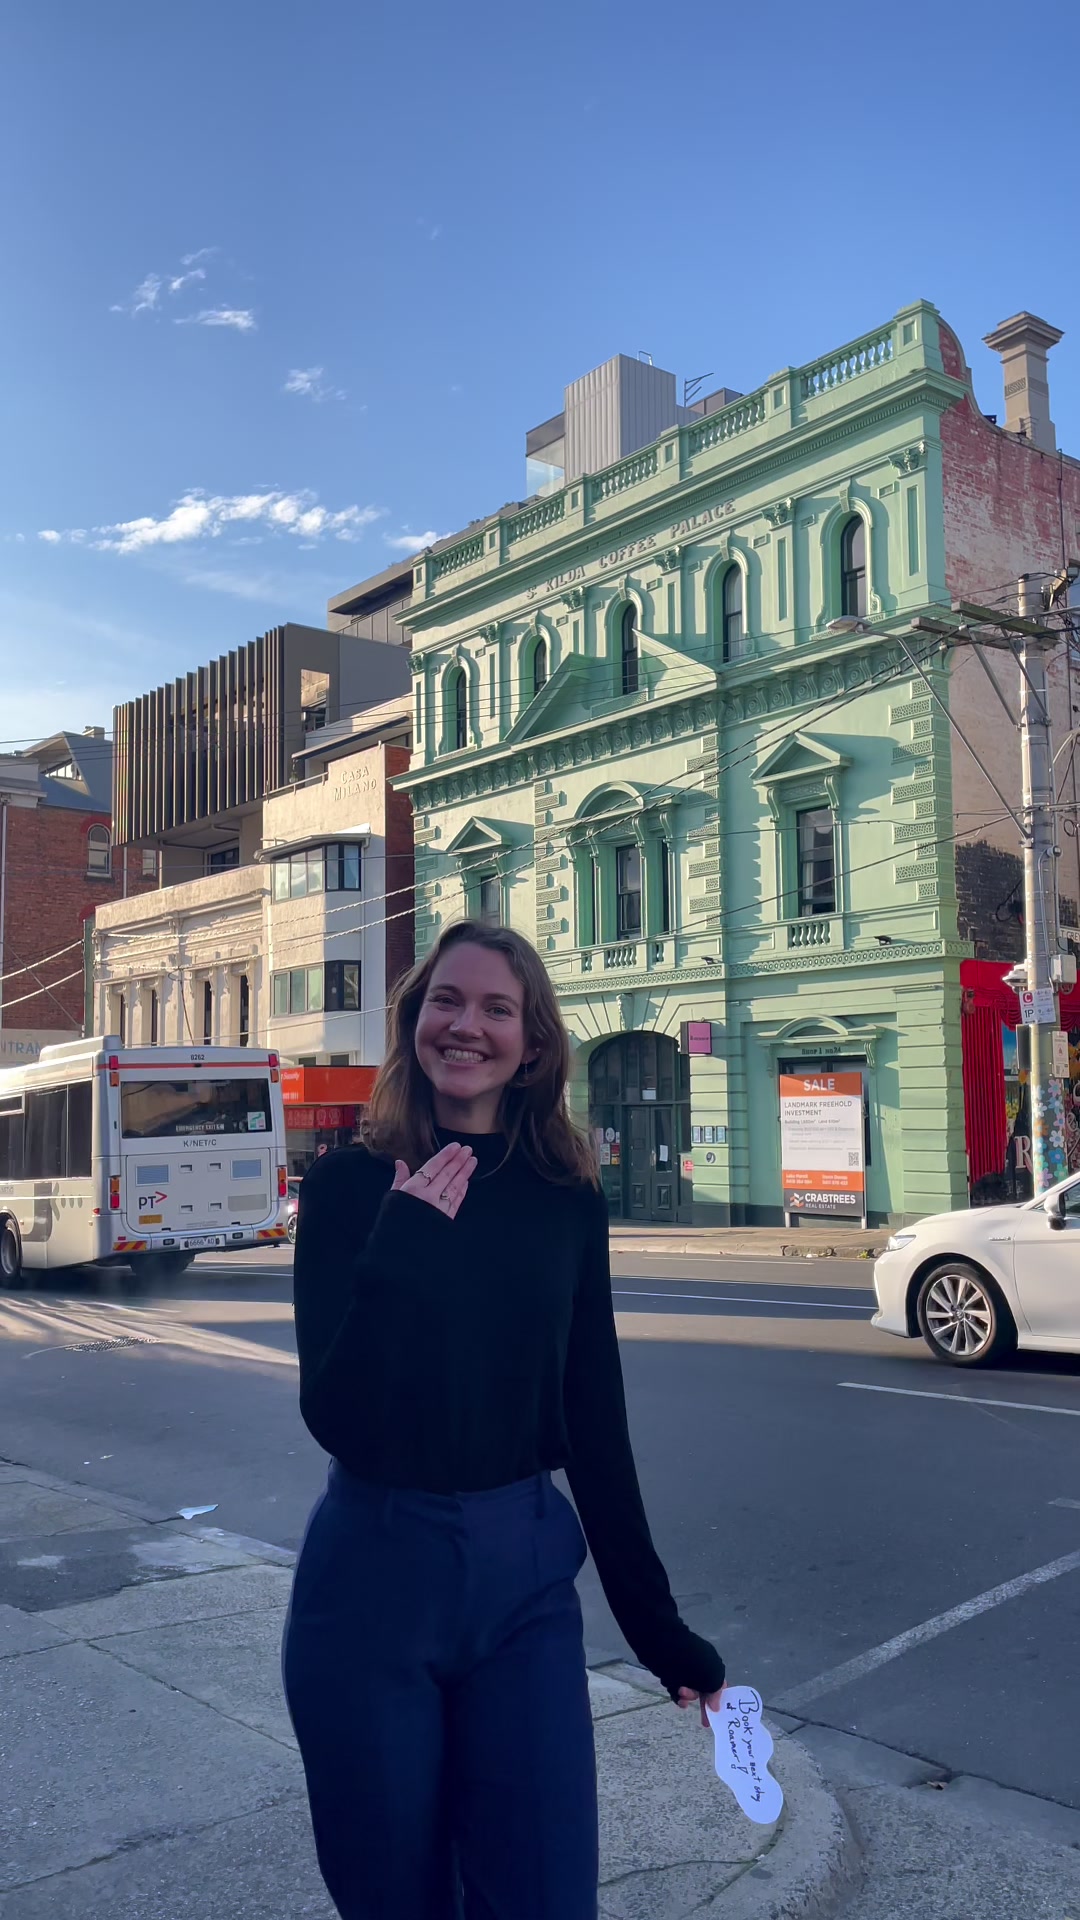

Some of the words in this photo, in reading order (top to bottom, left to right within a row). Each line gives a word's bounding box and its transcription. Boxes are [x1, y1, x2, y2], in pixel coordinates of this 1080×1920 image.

[545, 565, 586, 592] KILDA
[598, 533, 657, 568] COFFEE
[670, 498, 736, 539] PALACE
[341, 766, 369, 784] CASA
[334, 778, 377, 801] MILANO
[1024, 1009, 1034, 1018] 1P
[803, 1078, 835, 1091] SALE
[804, 1192, 856, 1204] CRABTREES
[726, 1702, 737, 1711] at
[738, 1690, 760, 1735] Book
[741, 1738, 754, 1758] your
[750, 1762, 762, 1782] next
[750, 1786, 765, 1802] stay
